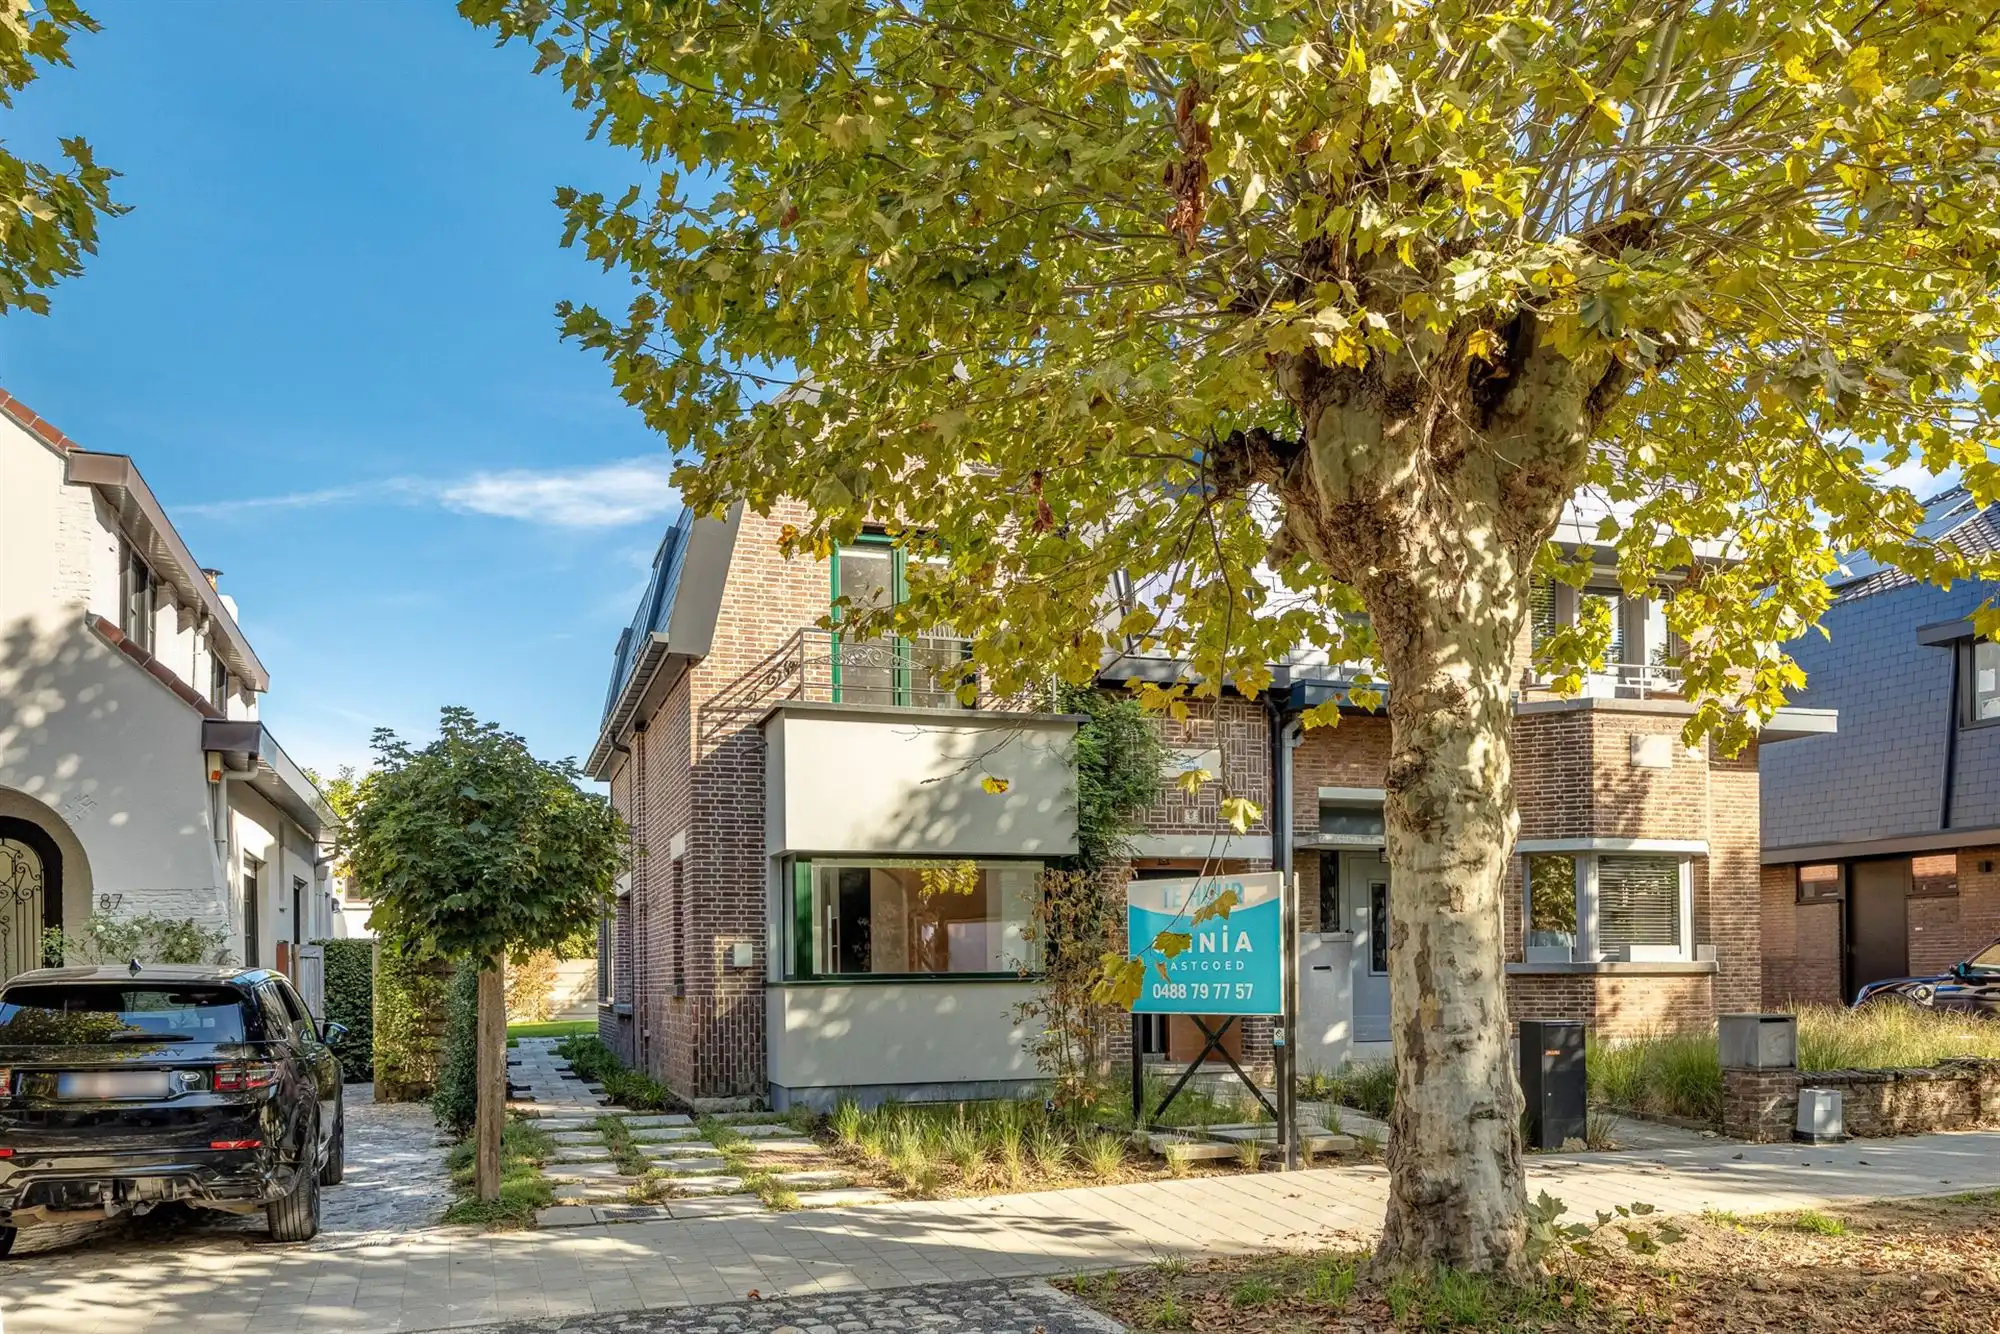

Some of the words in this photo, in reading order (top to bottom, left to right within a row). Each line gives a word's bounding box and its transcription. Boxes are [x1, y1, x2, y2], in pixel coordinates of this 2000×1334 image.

[100, 893, 122, 910] 87
[1160, 961, 1245, 971] ASTGOED
[1153, 983, 1187, 999] 0488
[1191, 983, 1209, 999] 79
[1213, 983, 1230, 999] 77
[1236, 983, 1254, 999] 57
